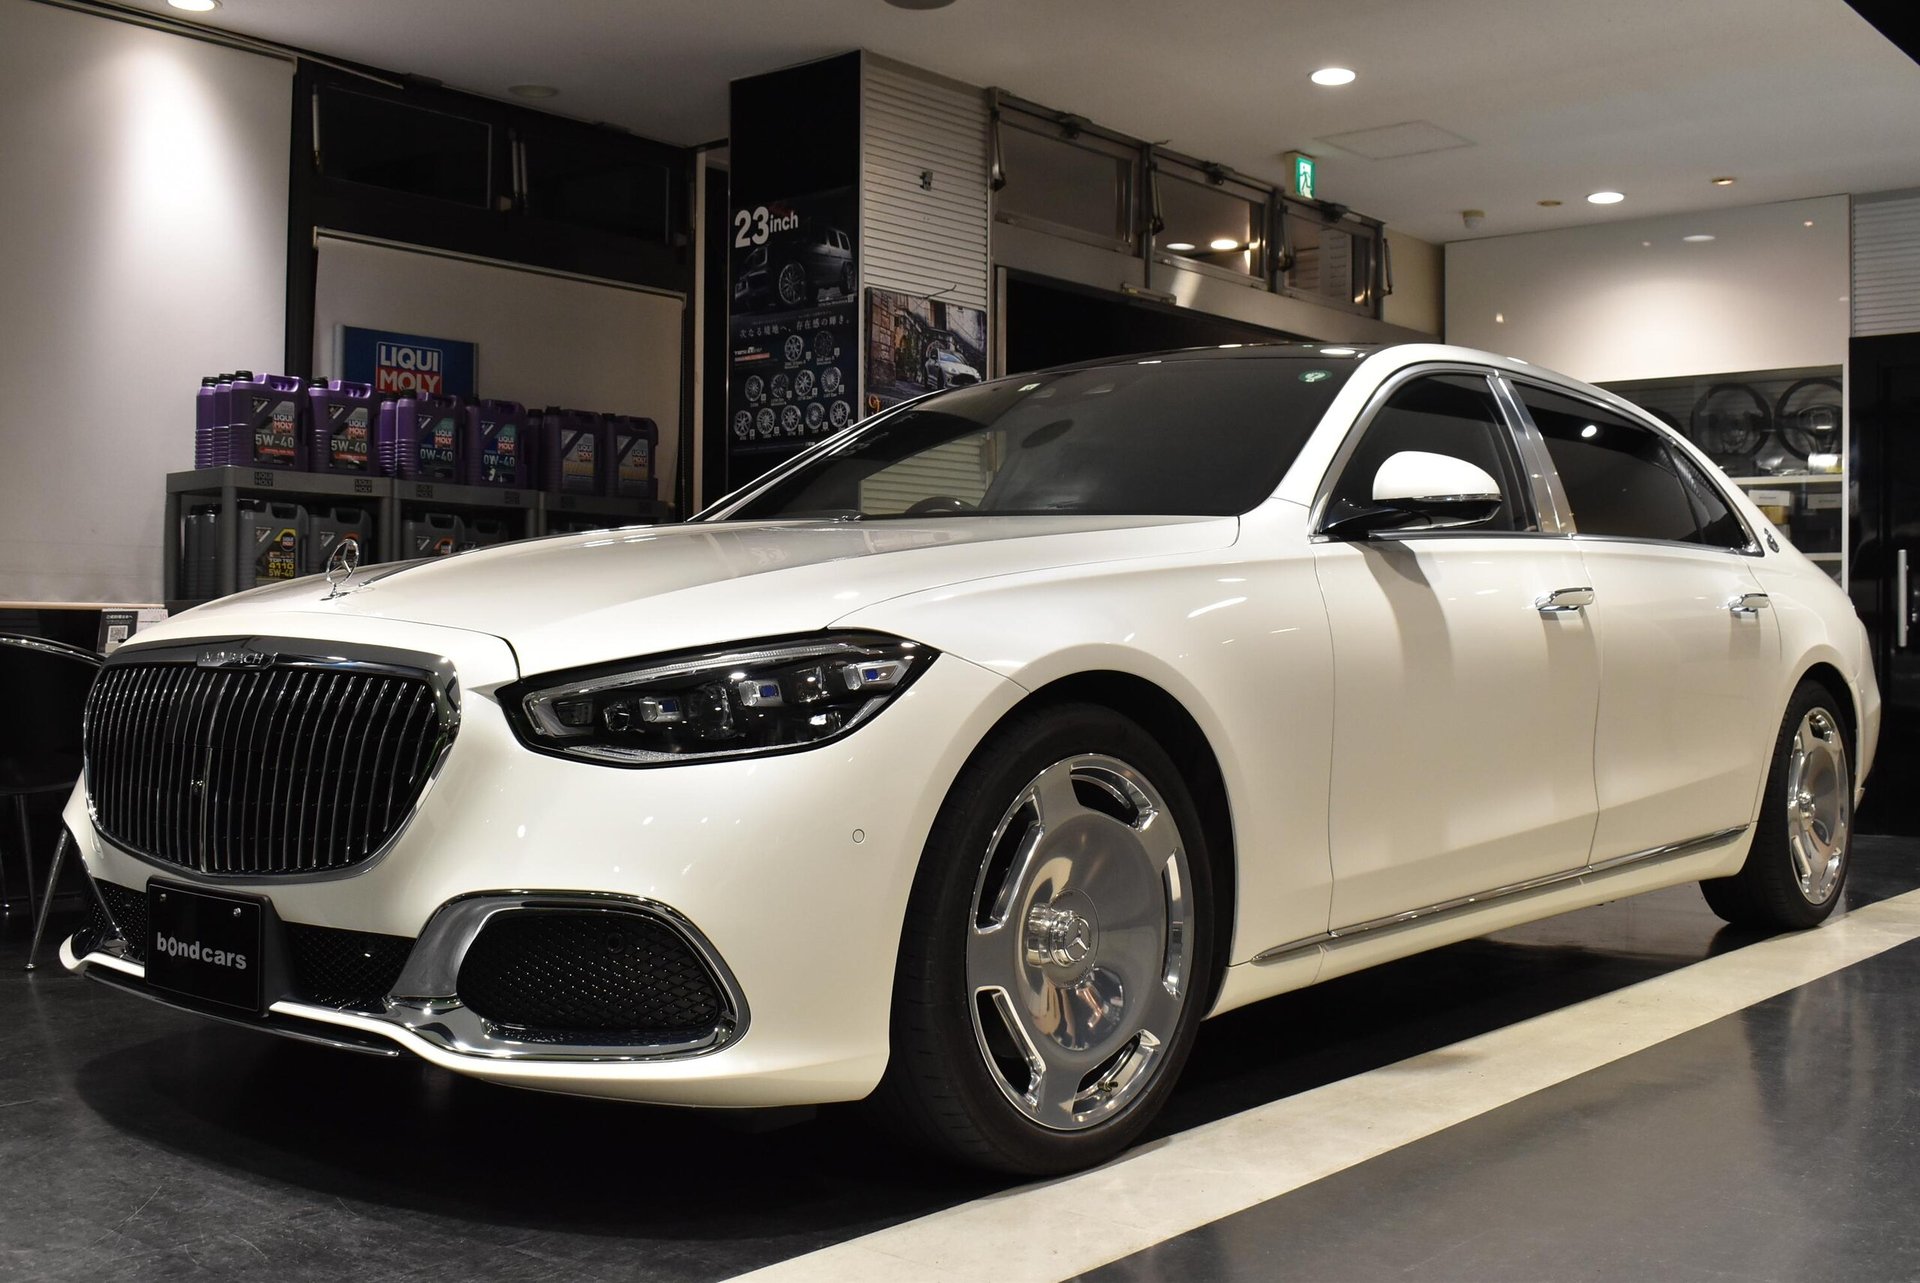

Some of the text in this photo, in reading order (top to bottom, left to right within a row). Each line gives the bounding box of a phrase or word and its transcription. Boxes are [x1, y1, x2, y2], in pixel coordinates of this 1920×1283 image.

[380, 345, 438, 372] LIQUI
[380, 369, 440, 393] MOLY
[273, 421, 294, 430] MOLY
[255, 434, 295, 448] 5W-40
[330, 439, 368, 454] 5W-40
[420, 448, 453, 462] 0W-40
[483, 454, 516, 467] 0W-40
[268, 568, 294, 577] 5W-40
